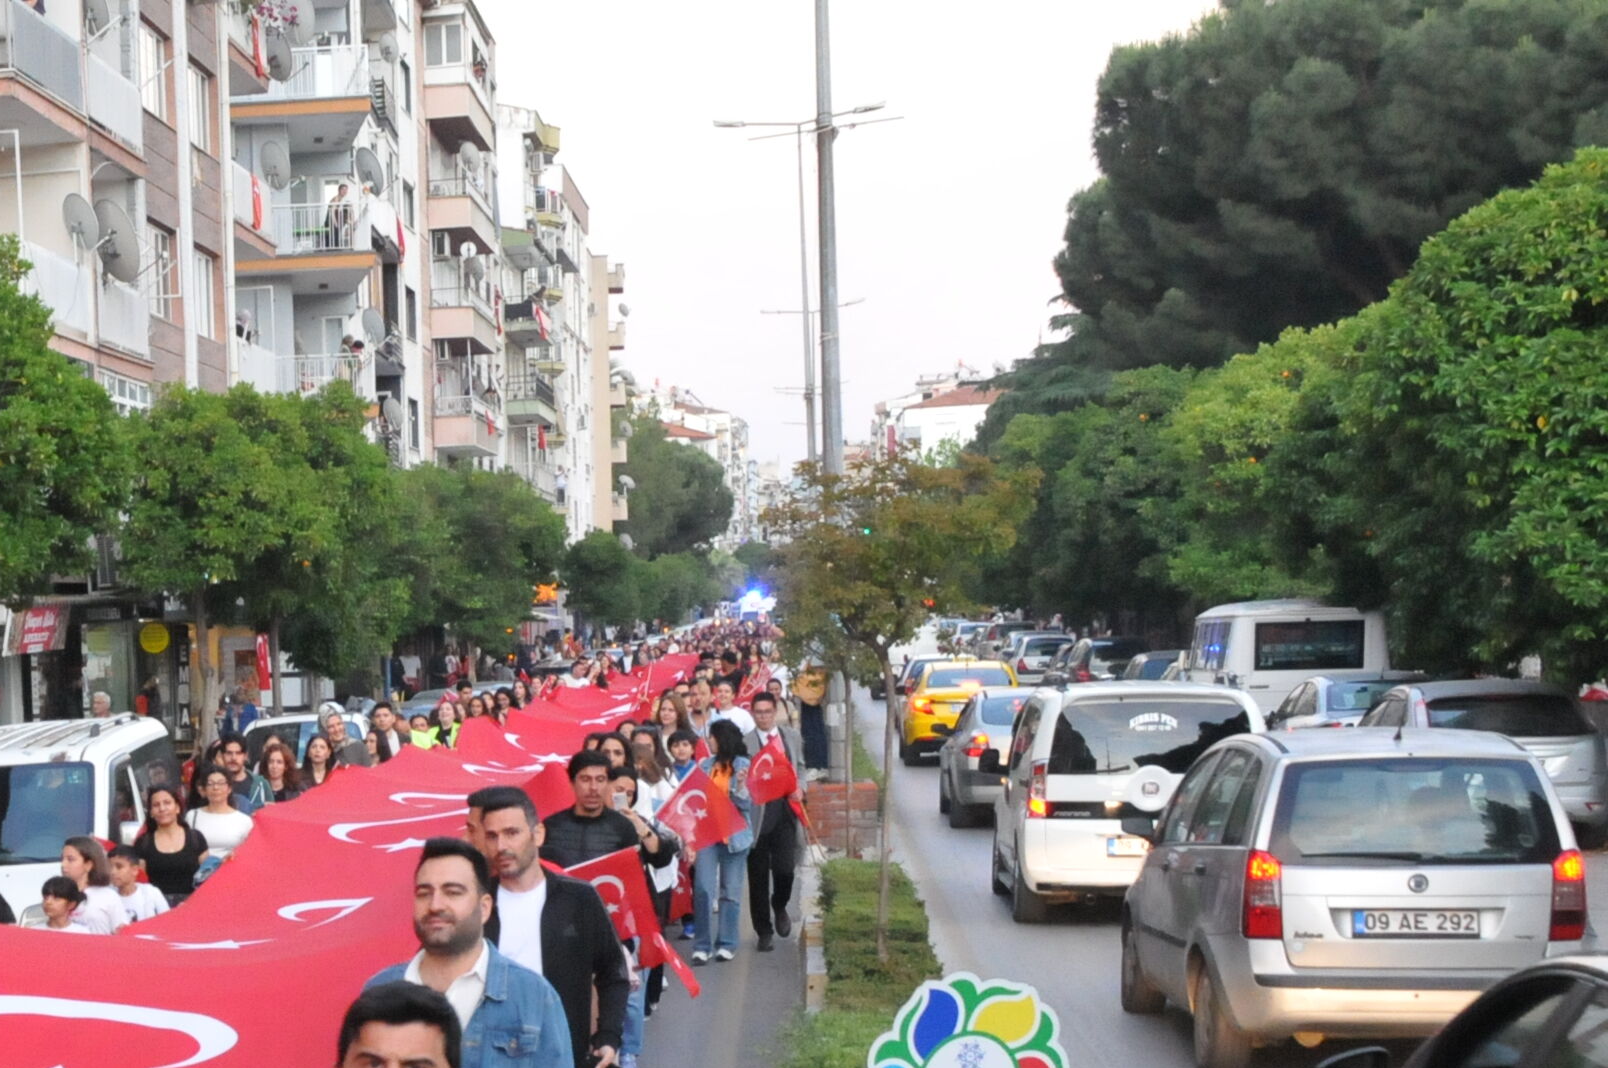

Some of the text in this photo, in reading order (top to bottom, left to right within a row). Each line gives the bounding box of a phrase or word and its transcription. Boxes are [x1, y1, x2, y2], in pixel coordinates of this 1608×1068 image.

[1364, 912, 1390, 931] 09
[1398, 912, 1428, 931] AE
[1435, 912, 1475, 932] 292
